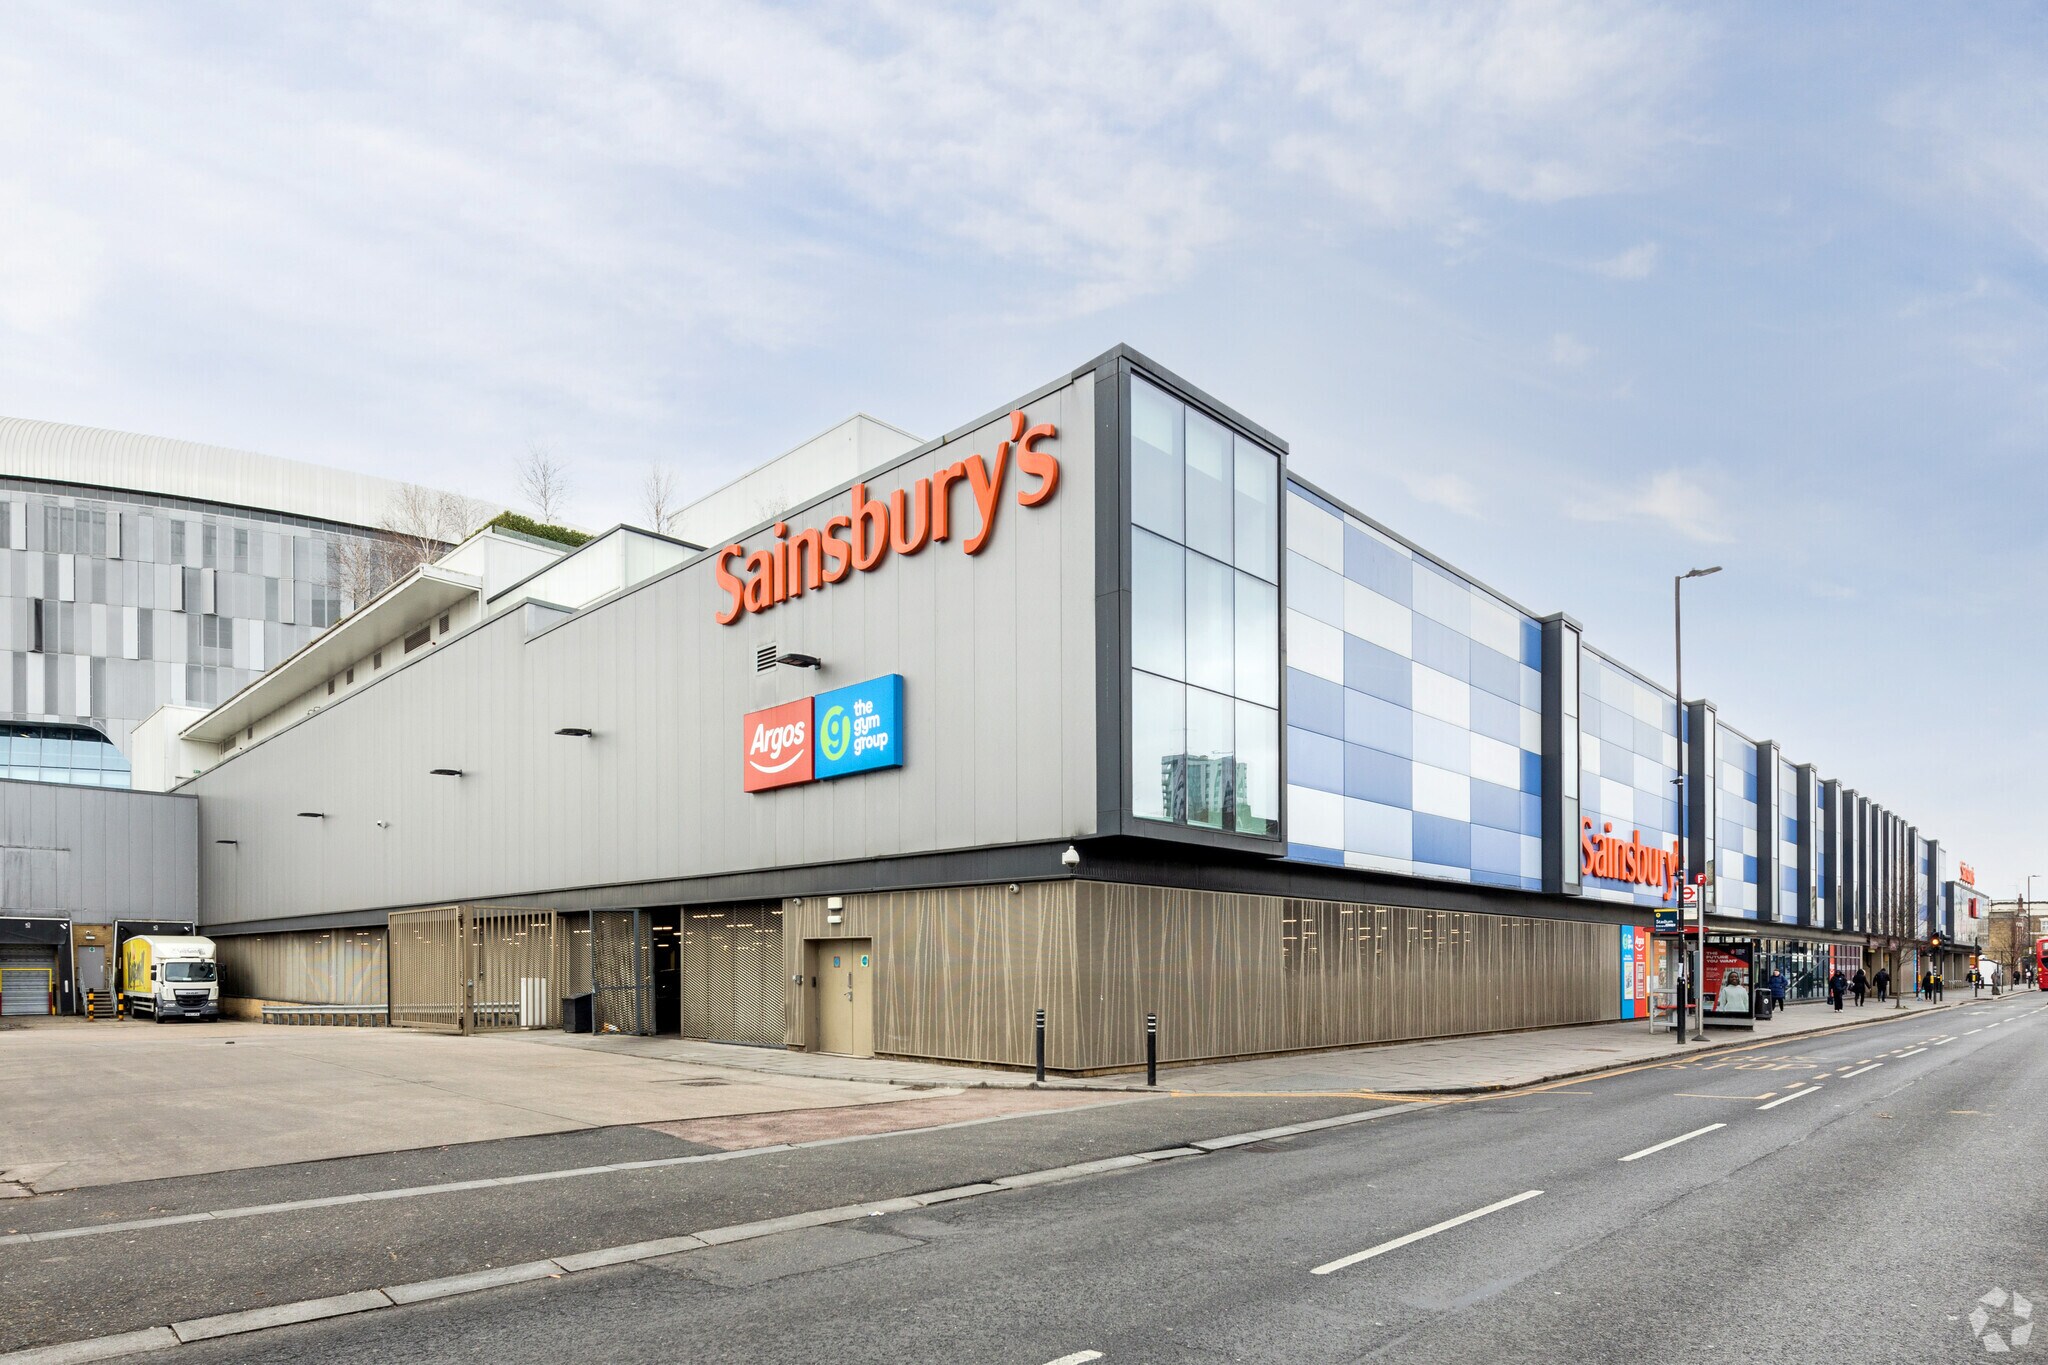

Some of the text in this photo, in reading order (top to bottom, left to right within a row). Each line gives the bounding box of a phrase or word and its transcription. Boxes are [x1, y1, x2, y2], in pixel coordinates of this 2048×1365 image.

[715, 410, 1060, 626] Sainsbury's
[854, 699, 873, 717] the
[854, 714, 880, 737] gym
[750, 721, 806, 760] Argos
[854, 732, 889, 757] group
[1697, 874, 1704, 884] F
